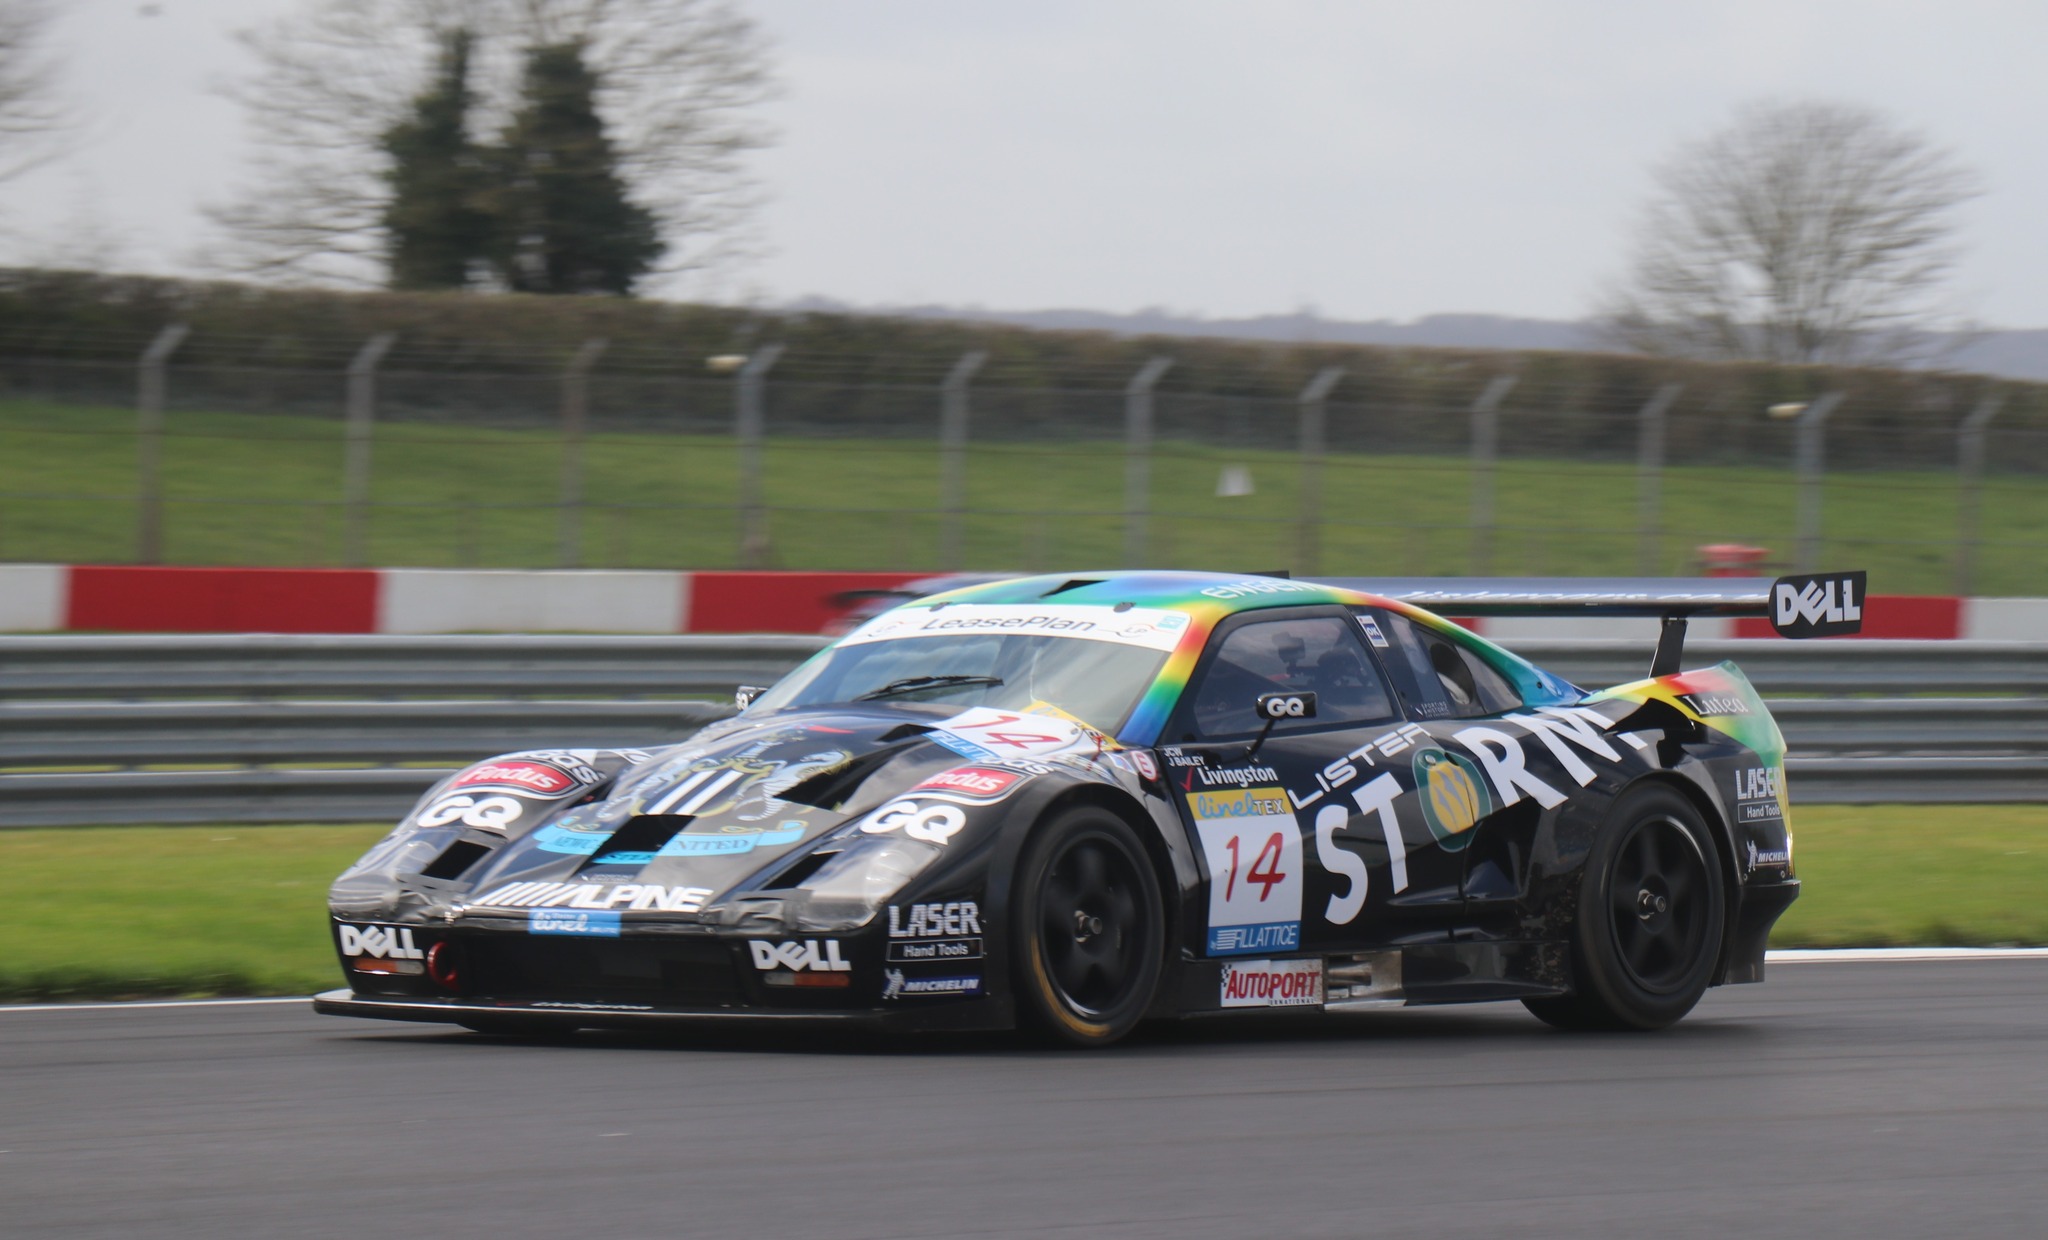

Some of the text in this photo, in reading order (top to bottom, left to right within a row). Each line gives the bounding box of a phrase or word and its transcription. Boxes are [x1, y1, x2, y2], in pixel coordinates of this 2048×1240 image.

[1776, 581, 1861, 626] DELL
[919, 616, 1097, 632] LeasePlan
[1266, 697, 1304, 717] GQ
[1682, 695, 1749, 715] Lutea
[1164, 747, 1182, 757] JCW
[1175, 756, 1204, 767] BAILEY
[1287, 722, 1431, 810] LISTER
[460, 765, 559, 789] Findus
[1197, 764, 1279, 788] Livingston
[1735, 767, 1784, 800] LASER
[418, 797, 523, 830] GQ
[860, 801, 966, 845] GQ
[1747, 804, 1781, 818] Hand Tools
[1226, 832, 1286, 902] 14
[541, 883, 713, 912] ALPINE
[888, 902, 982, 937] LASER
[339, 925, 424, 959] DELL
[749, 940, 851, 972] DELL
[903, 943, 969, 957] Hand Tools
[904, 979, 980, 991] MICHELIN
[1225, 970, 1320, 999] AUTOPORT
